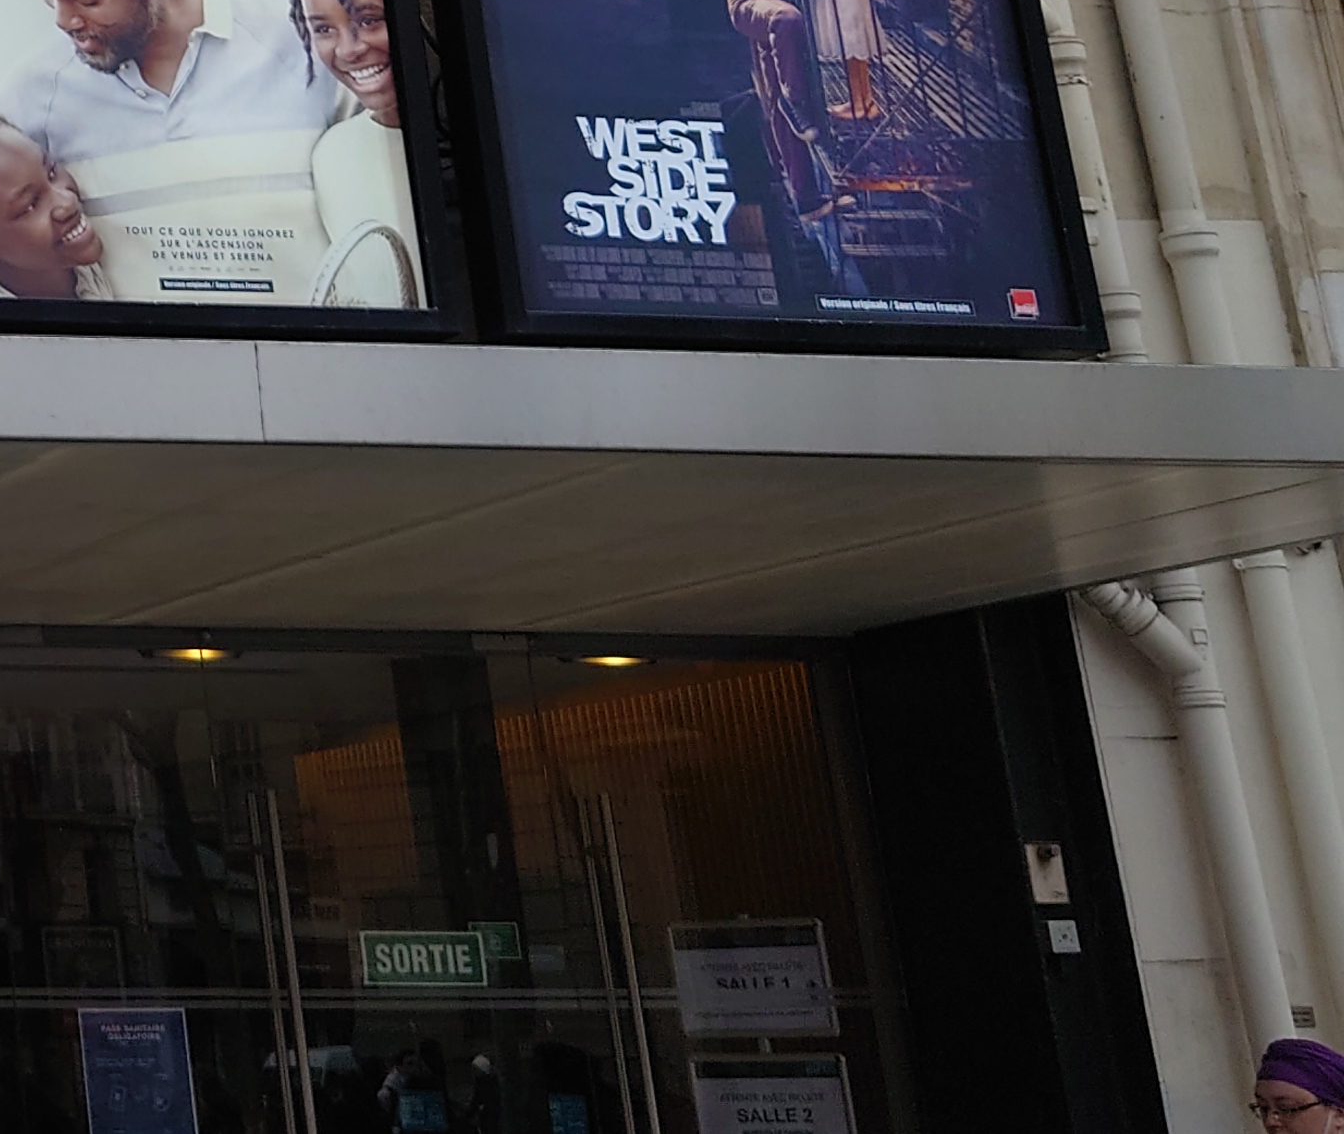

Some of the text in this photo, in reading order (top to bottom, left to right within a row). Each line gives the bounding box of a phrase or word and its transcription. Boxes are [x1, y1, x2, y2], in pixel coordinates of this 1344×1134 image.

[576, 116, 725, 163] WEST
[607, 155, 728, 200] SIDE
[563, 192, 736, 244] STORY
[125, 226, 294, 238] TOUT CE QUE VOUS IGNOREZ
[160, 239, 264, 249] SUR L'ASCENSION
[152, 250, 273, 261] DE VENUS ET SERENA
[820, 298, 851, 309] Version
[853, 299, 888, 311] originale
[894, 301, 914, 310] Sous
[937, 303, 970, 314] Français
[375, 942, 472, 974] SORTIE
[737, 1108, 814, 1124] SALLE 2
